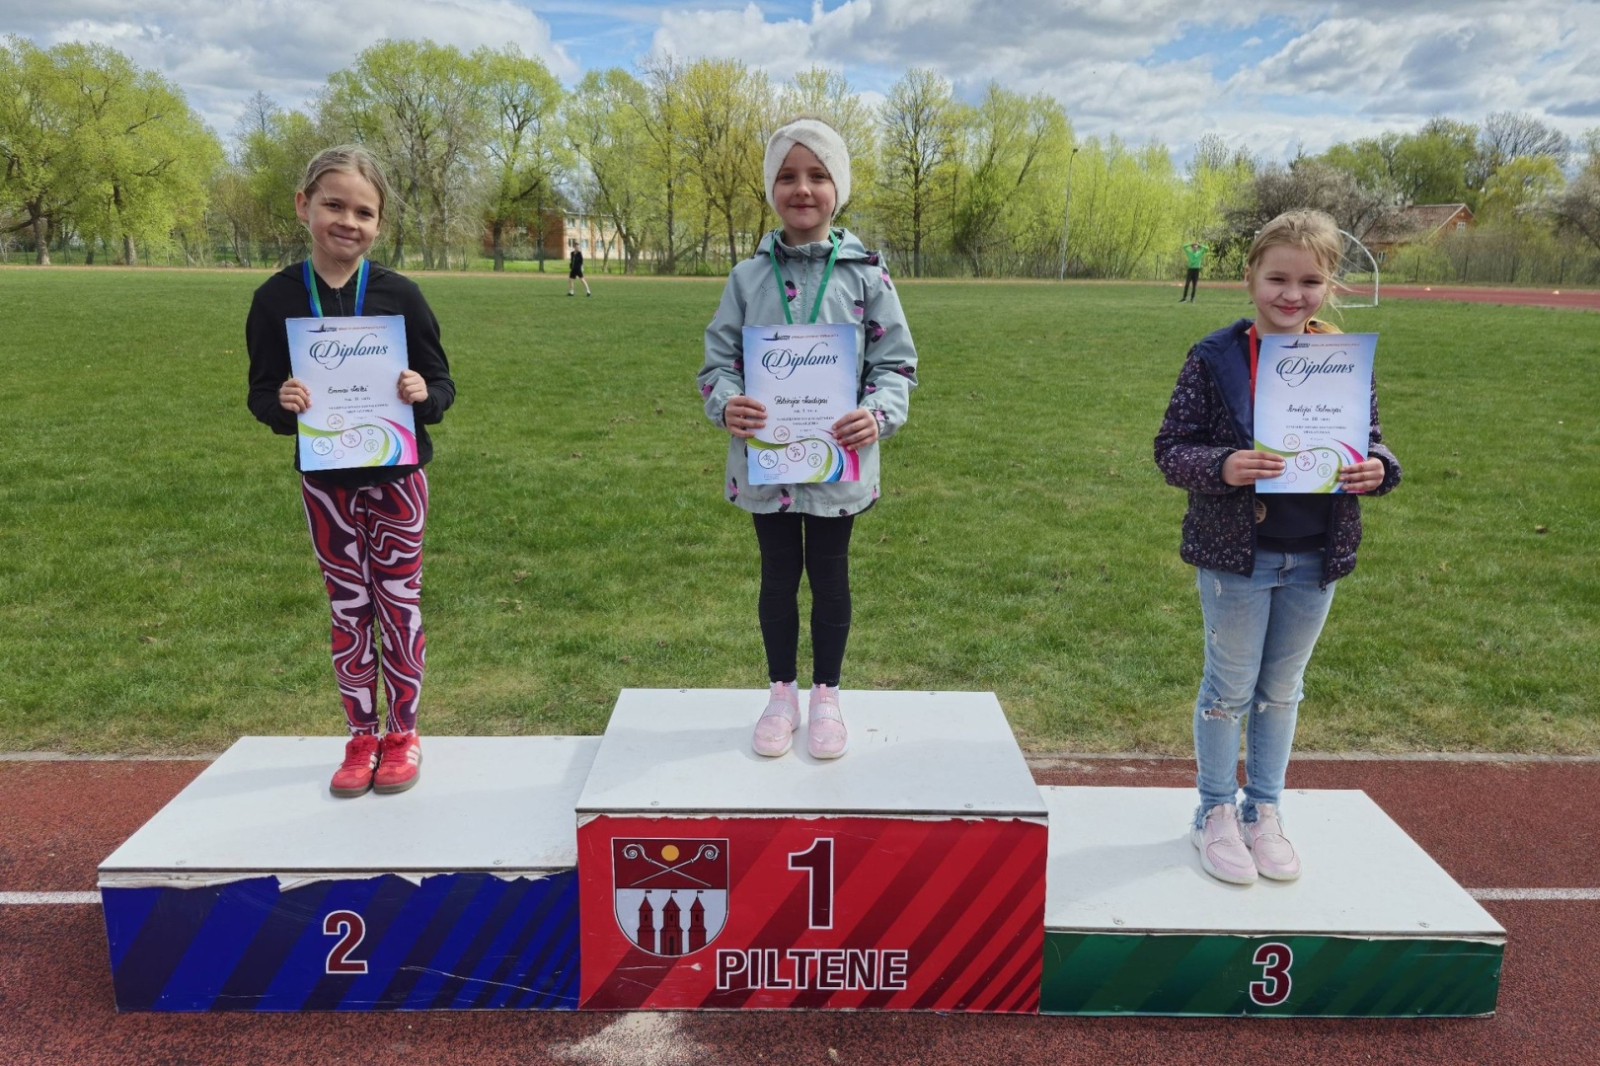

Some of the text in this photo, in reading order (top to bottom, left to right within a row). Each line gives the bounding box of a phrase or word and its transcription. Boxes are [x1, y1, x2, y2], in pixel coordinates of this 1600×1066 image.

[309, 333, 389, 370] Diploms
[761, 341, 839, 380] Diploms
[1276, 350, 1355, 388] Diploms
[788, 837, 834, 930] 1
[323, 909, 369, 974] 2
[716, 948, 908, 991] PILTENE
[1249, 942, 1293, 1006] 3
